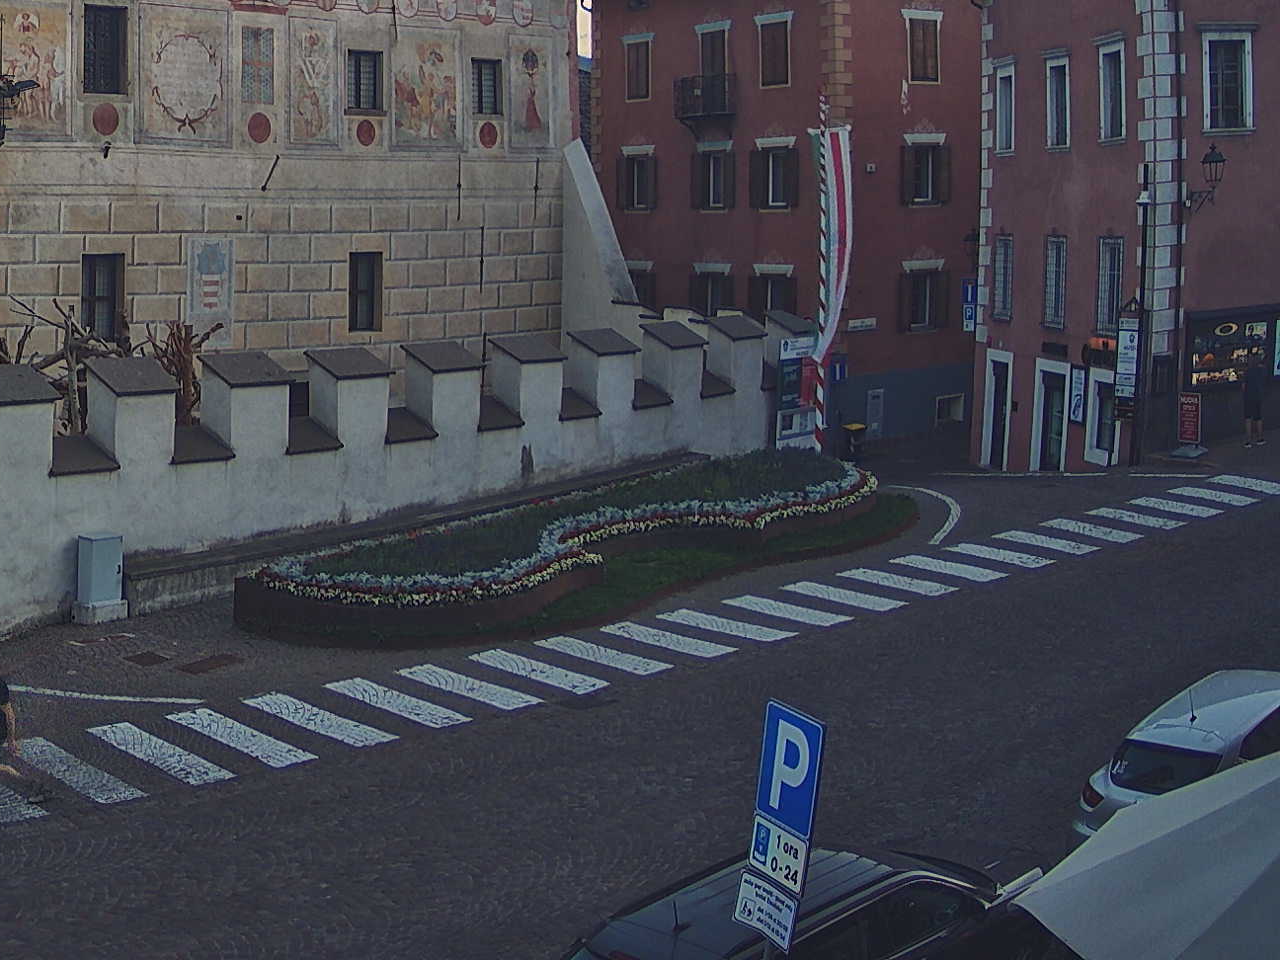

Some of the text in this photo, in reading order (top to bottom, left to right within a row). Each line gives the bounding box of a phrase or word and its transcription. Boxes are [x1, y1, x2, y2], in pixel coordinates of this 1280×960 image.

[769, 719, 809, 809] P
[776, 834, 799, 860] 1 ora
